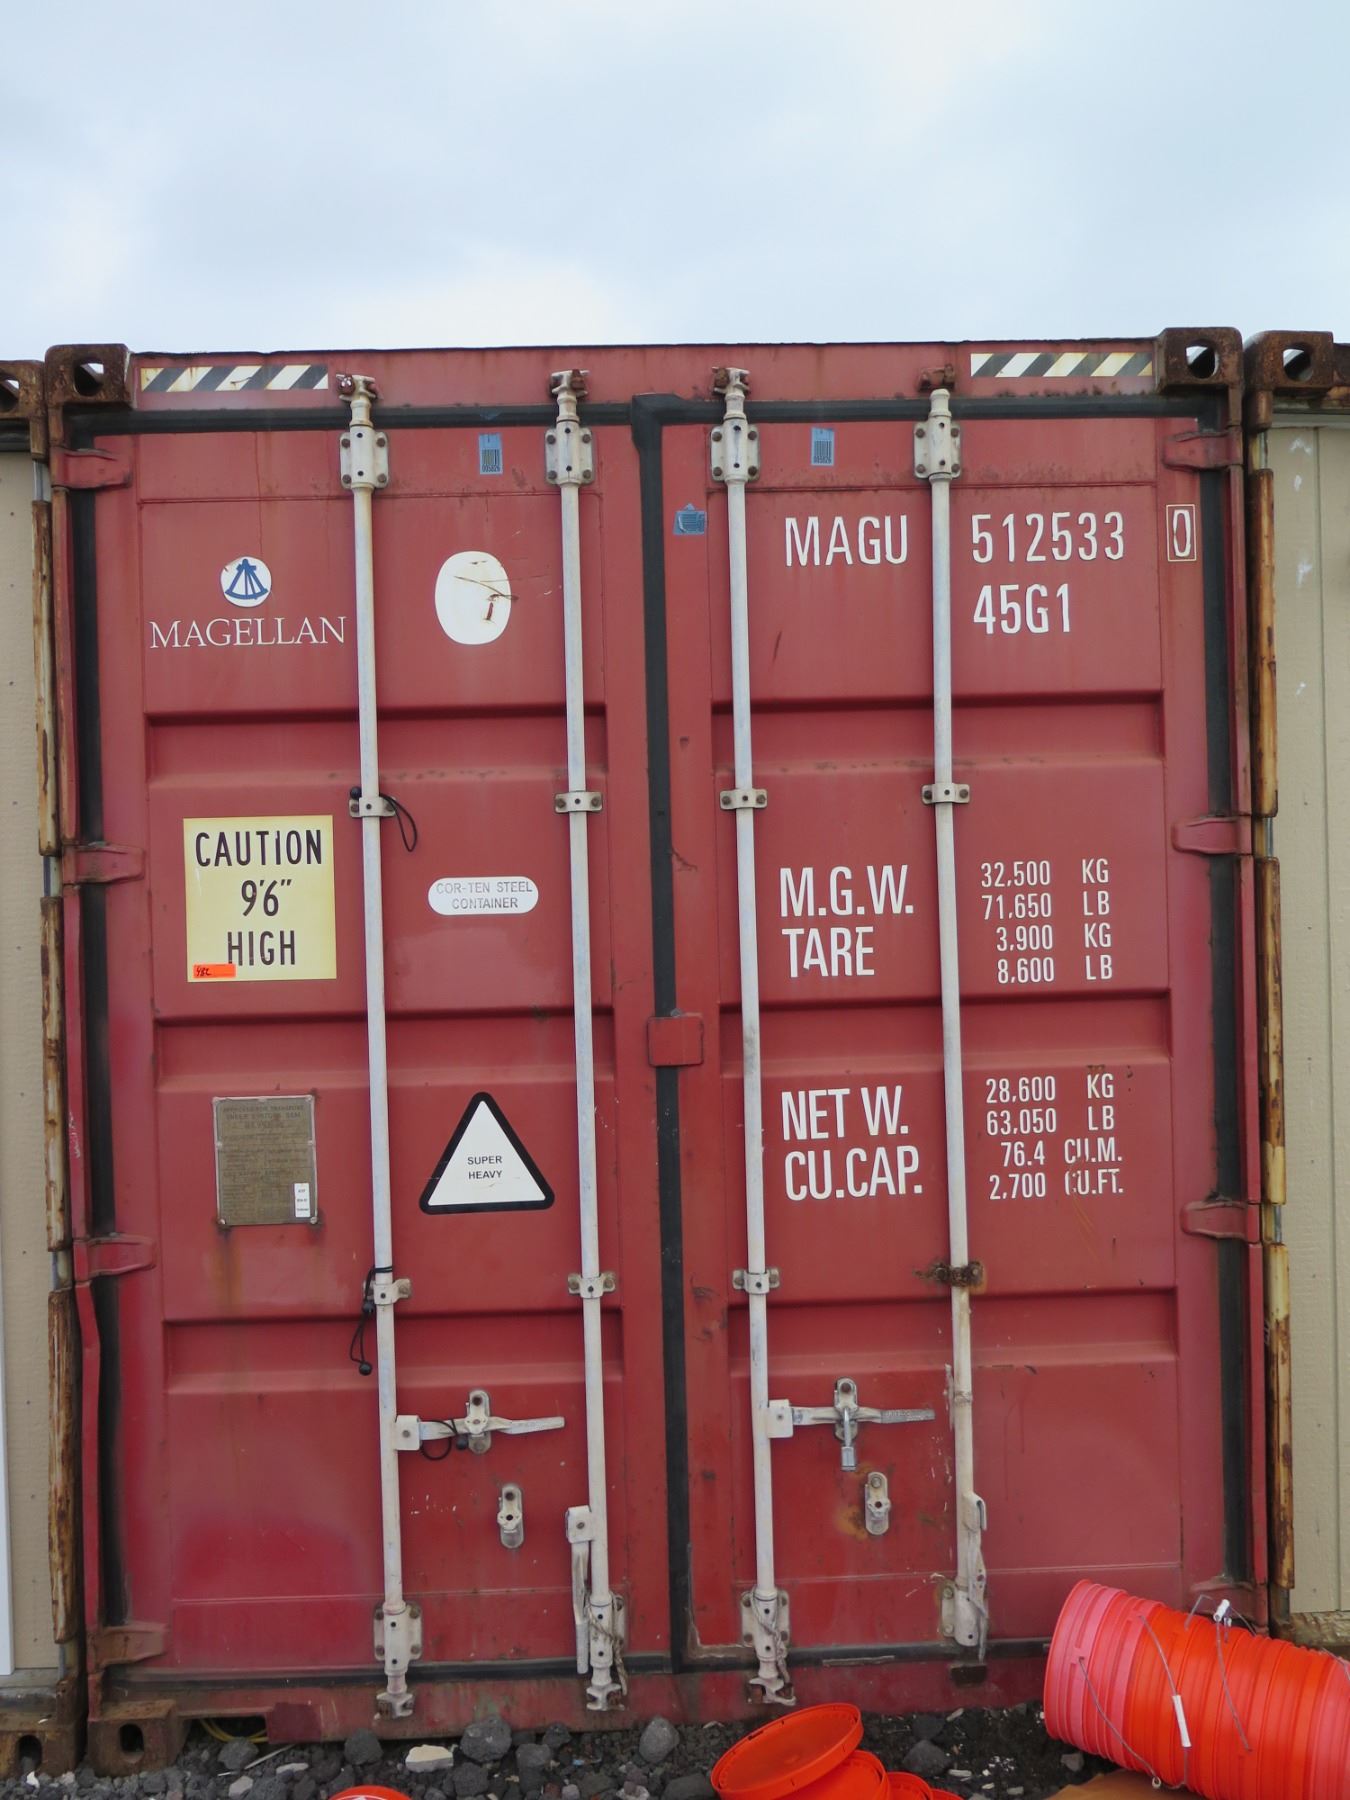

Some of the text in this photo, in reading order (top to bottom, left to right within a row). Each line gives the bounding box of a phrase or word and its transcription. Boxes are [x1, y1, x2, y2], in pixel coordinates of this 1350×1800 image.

[785, 509, 1191, 567] MAGU 512533 0
[973, 583, 1070, 635] 45G1
[150, 616, 347, 650] MAGELLAN
[195, 829, 322, 867] CAUTION
[1082, 858, 1109, 884] KG
[436, 881, 533, 895] COR-TEN STEEL
[780, 864, 914, 918] M.G.W.
[452, 897, 519, 910] CONTAINER
[1083, 890, 1110, 916] LB
[227, 930, 296, 967] HIGH
[1084, 922, 1112, 948] KG
[781, 926, 875, 978] TARE
[1085, 954, 1113, 980] LB
[1087, 1073, 1114, 1099] KG
[781, 1085, 909, 1141] NET W.
[1087, 1105, 1115, 1131] LB
[467, 1155, 503, 1166] SUPER
[1000, 1136, 1123, 1167] 76.4 CU.M.
[468, 1170, 503, 1180] HEAVY
[784, 1145, 923, 1201] CU.CAP.
